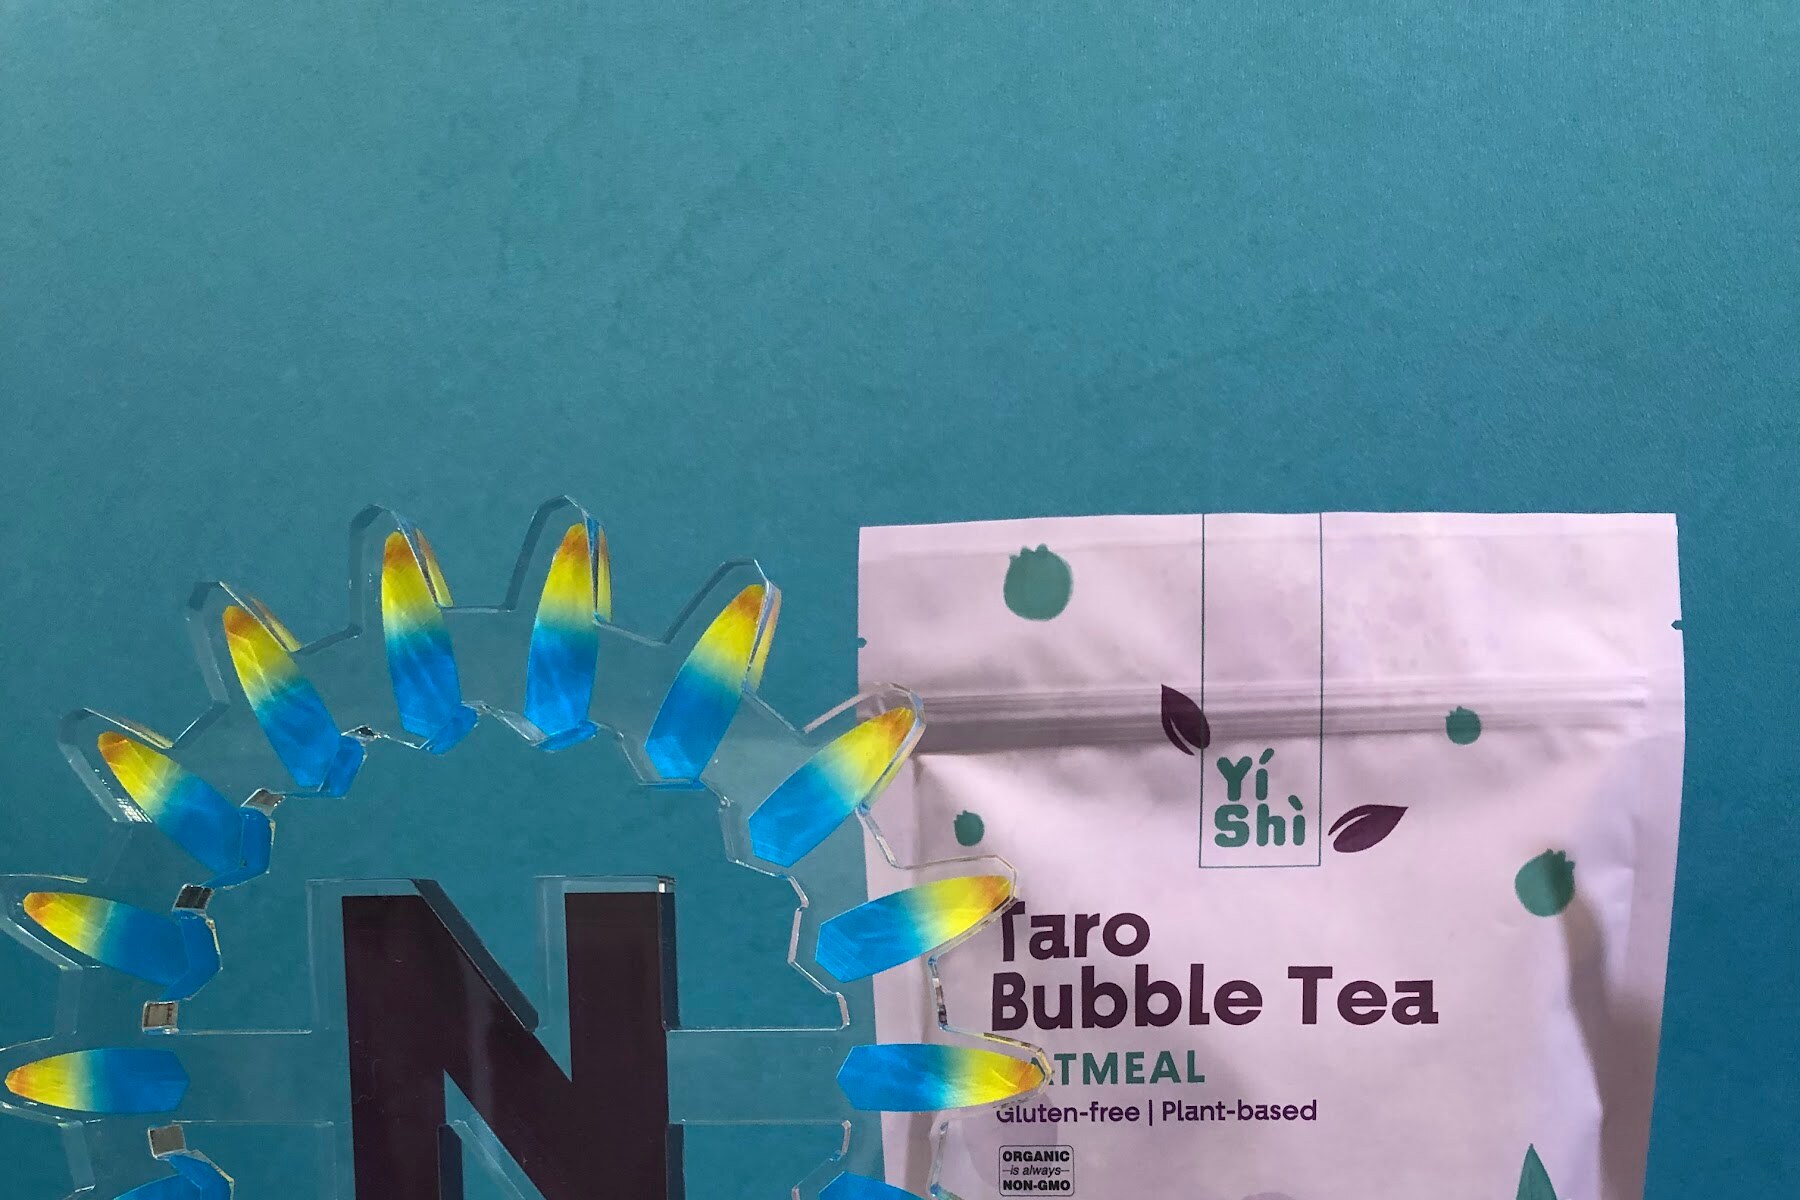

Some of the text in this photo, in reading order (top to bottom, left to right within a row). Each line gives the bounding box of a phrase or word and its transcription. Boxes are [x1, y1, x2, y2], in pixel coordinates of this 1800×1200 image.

[1216, 748, 1275, 802] Yí
[1214, 795, 1306, 848] Shì
[995, 901, 1151, 962] Taro
[991, 964, 1439, 1031] Bubble Tea
[1044, 1050, 1206, 1086] TMEAL
[996, 1101, 1140, 1123] Gluten-free
[1162, 1100, 1317, 1123] Plant-based
[1002, 1150, 1070, 1162] ORGANIC
[1010, 1165, 1061, 1177] is always
[1003, 1180, 1071, 1191] NON-GMO
